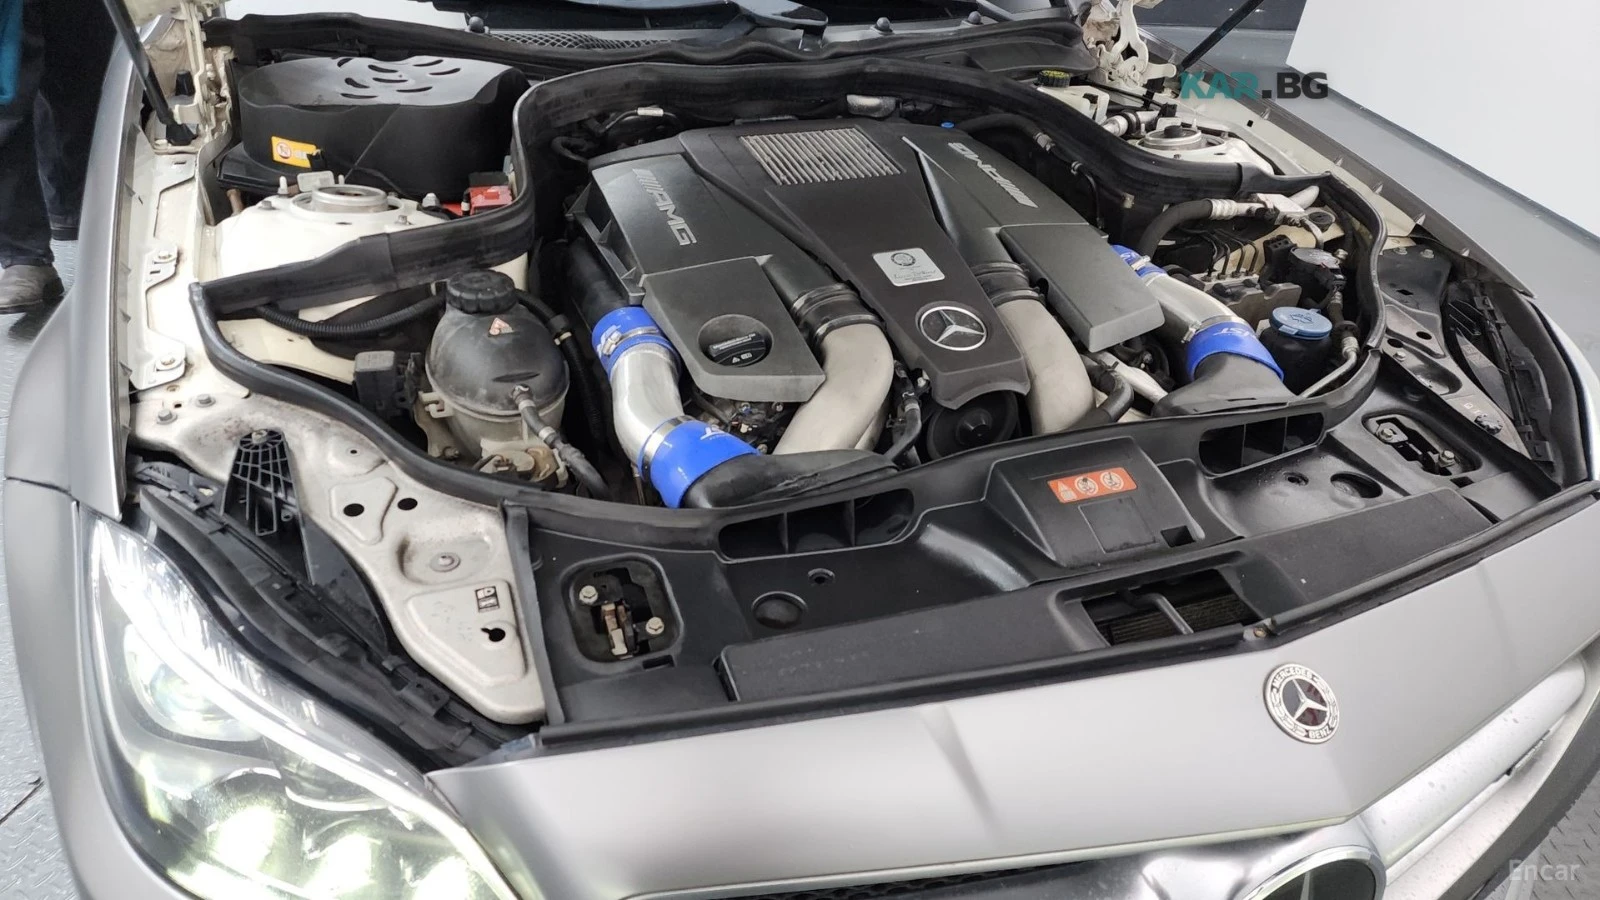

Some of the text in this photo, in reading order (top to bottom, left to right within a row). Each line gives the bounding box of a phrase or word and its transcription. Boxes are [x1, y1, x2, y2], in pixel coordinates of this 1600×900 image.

[647, 188, 697, 245] AMG
[1271, 667, 1313, 689] MERCEDES
[1309, 726, 1333, 740] BENZ
